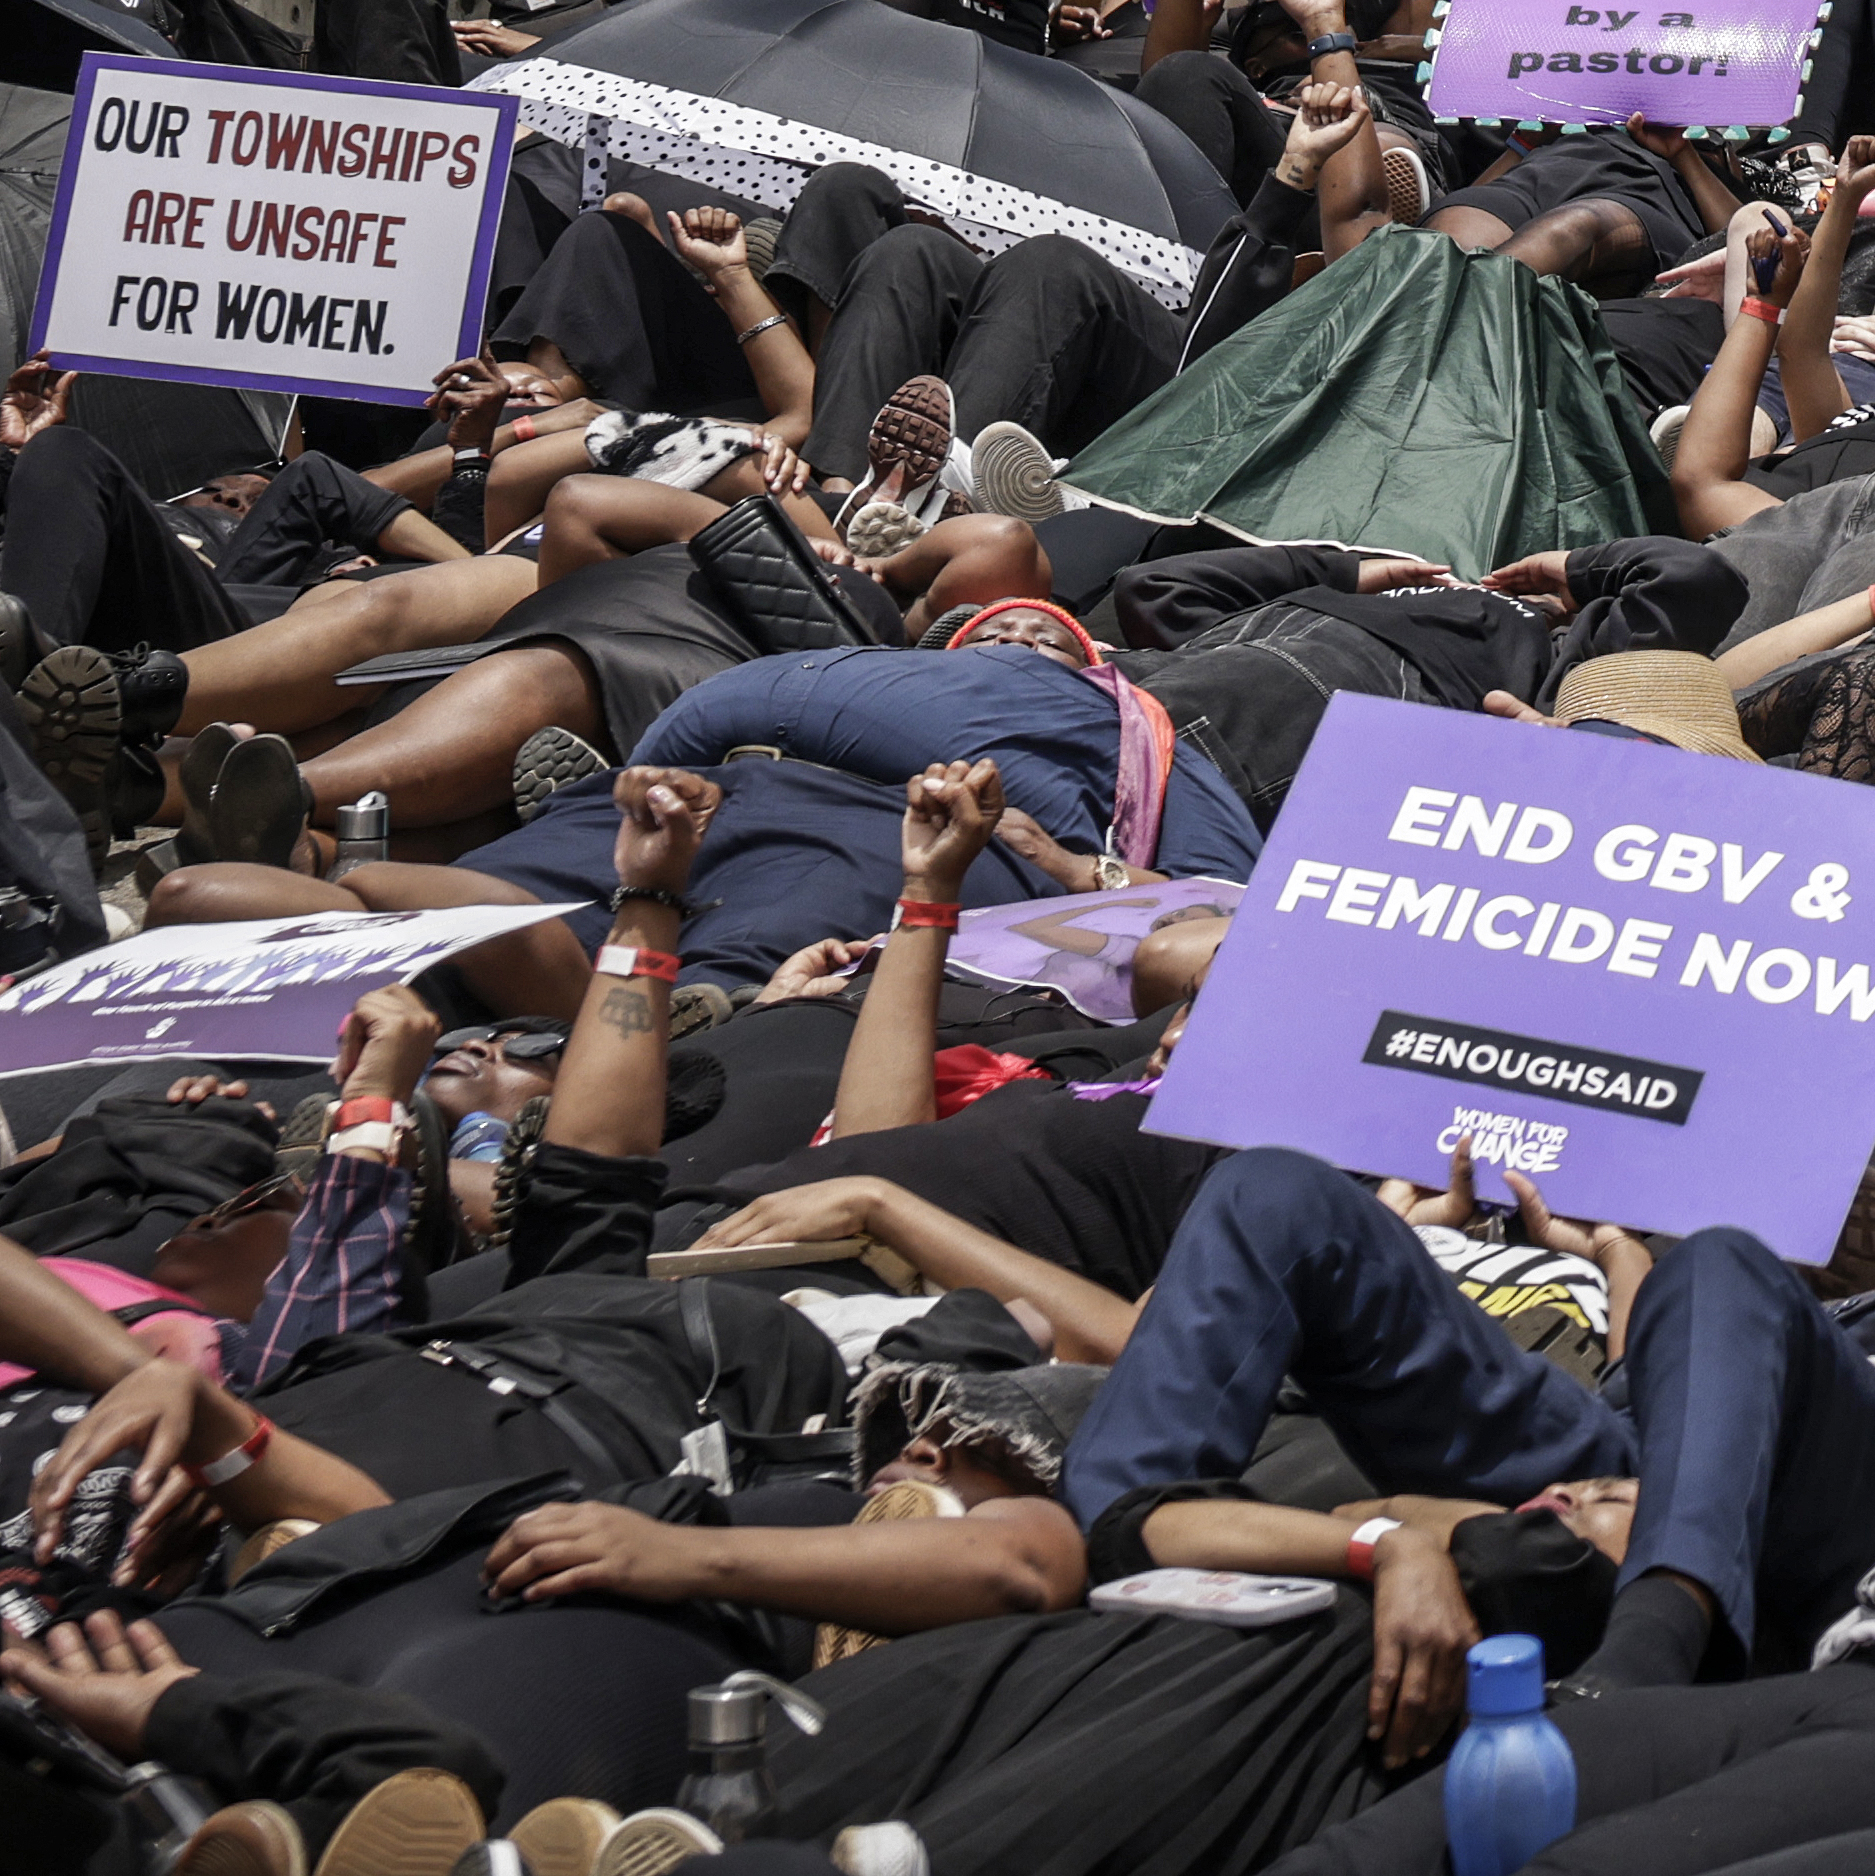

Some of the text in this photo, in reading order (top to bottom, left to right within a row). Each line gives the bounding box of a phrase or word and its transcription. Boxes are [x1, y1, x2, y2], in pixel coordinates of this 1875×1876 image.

[1564, 5, 1696, 32] by a
[1507, 47, 1730, 80] pastor!
[94, 96, 480, 189] OUR TOWNSHIPS
[123, 189, 406, 269] ARE UNSAFE
[108, 275, 395, 357] FOR WOMEN.
[1387, 785, 1852, 925] END GBV &
[1275, 858, 1674, 980] FEMICIDE
[1384, 1028, 1678, 1111] #ENOUGHSAID
[1452, 1106, 1569, 1148] WOMEN FOR
